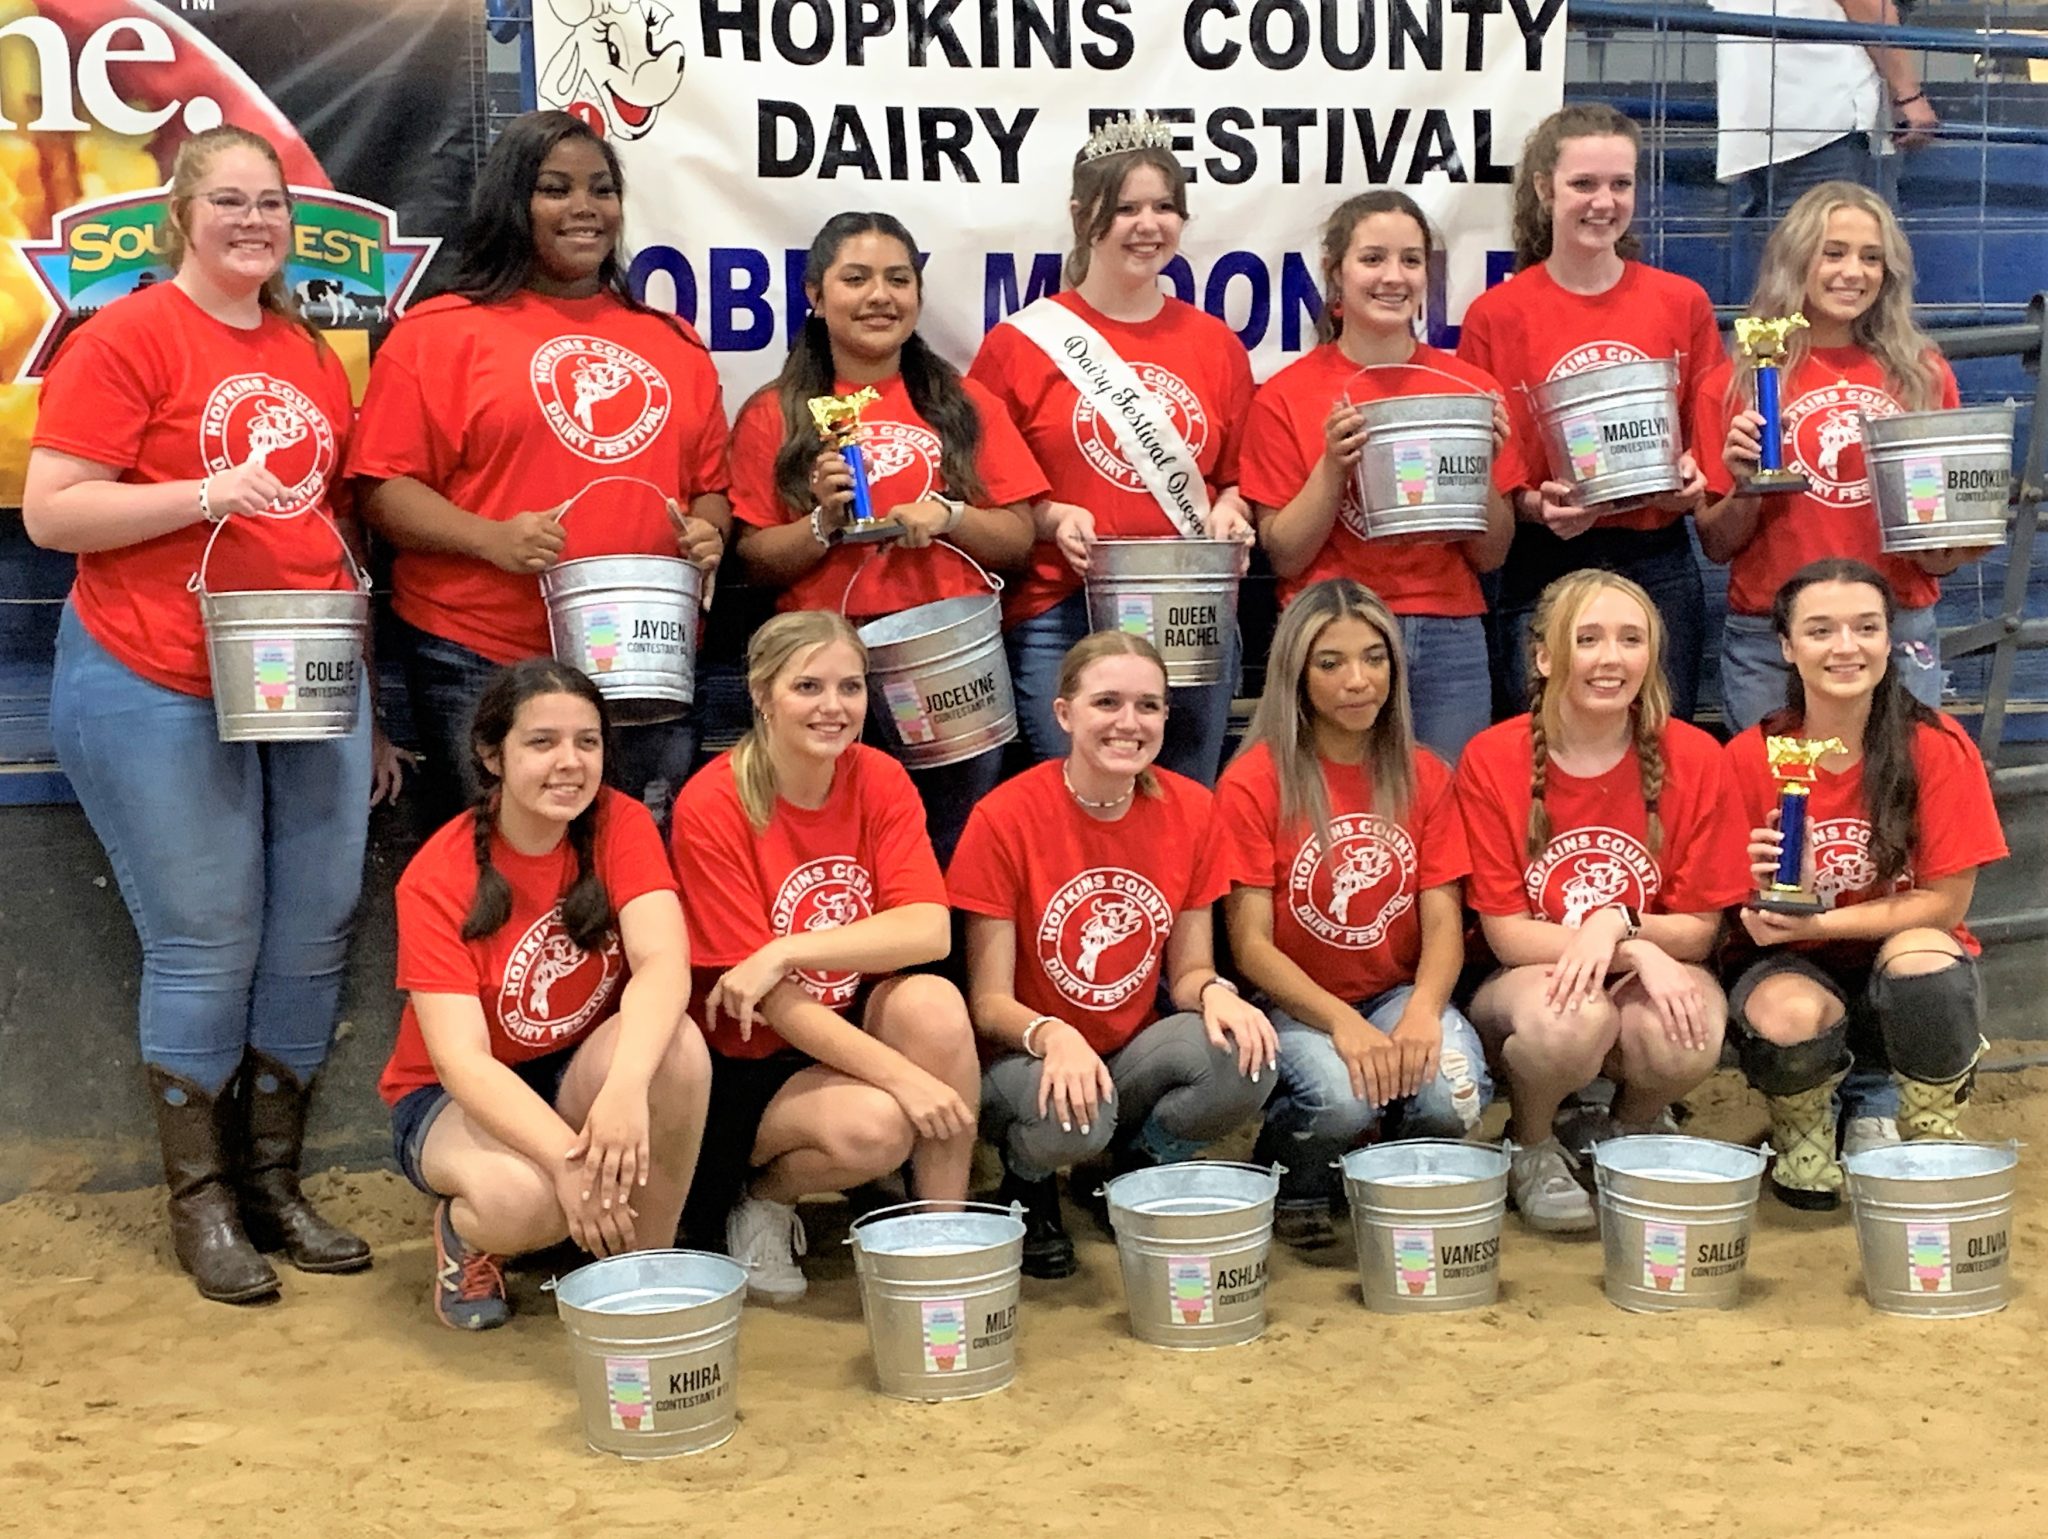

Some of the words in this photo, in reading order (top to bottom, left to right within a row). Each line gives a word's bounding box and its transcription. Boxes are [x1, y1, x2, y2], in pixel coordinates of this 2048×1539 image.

[702, 0, 1136, 71] HOPKINS
[1182, 0, 1566, 71] COUNTY
[757, 98, 1039, 184] DAIRY
[69, 222, 380, 275] SOUEST
[535, 339, 586, 384] HOPKINS
[591, 341, 665, 389] COUNTY
[206, 378, 265, 437] HOPKINS
[269, 382, 332, 451] COUNTY
[1063, 335, 1113, 396] Dairy
[1111, 387, 1177, 472] Festival
[1142, 367, 1203, 425] COUNTY
[546, 400, 590, 449] DAIRY
[593, 404, 665, 456] FESTIVAL
[1603, 416, 1669, 443] MADELYN
[1083, 438, 1127, 479] DAIRY
[1438, 456, 1488, 475] ALLISON
[632, 619, 686, 642] JAYDEN
[1169, 605, 1217, 626] QUEEN
[1165, 627, 1220, 647] RACHEL
[925, 672, 996, 714] JOCELYNE
[1294, 821, 1354, 891] HOPNS
[1596, 833, 1659, 896] COUNTY
[1042, 874, 1106, 942] HOPKINS
[1112, 874, 1170, 935] COUNTY
[1297, 904, 1342, 940] DAIRY
[1045, 957, 1090, 999] DAIRY
[504, 1009, 547, 1041] DAIRY
[668, 1363, 721, 1395] KHIRA
[655, 1389, 715, 1412] CONTESTANT
